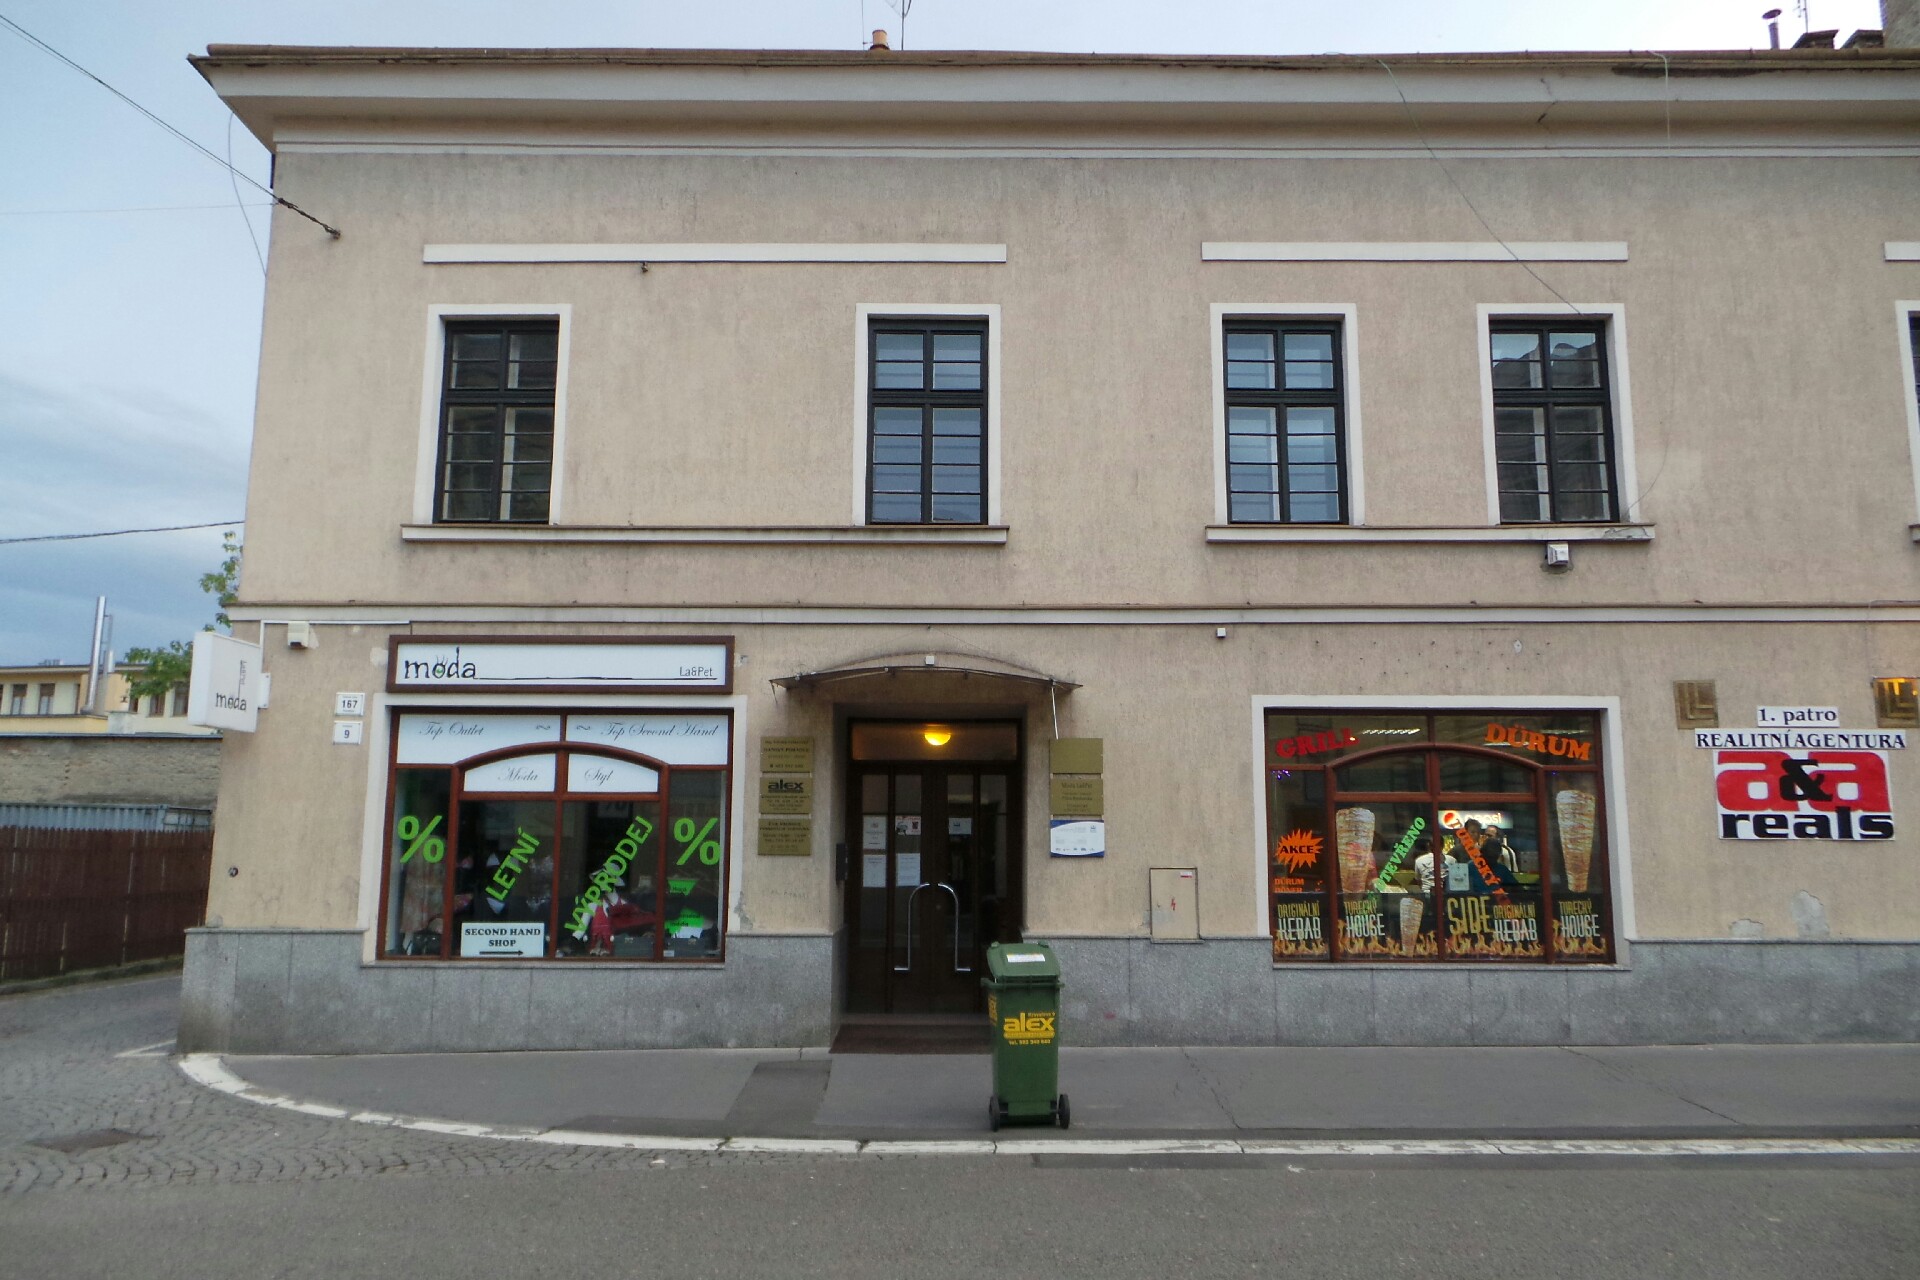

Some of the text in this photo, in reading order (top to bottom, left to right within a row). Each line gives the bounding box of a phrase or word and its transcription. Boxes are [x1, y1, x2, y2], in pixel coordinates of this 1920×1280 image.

[404, 646, 477, 680] moda
[679, 666, 714, 678] La&Pet
[215, 692, 248, 711] moda
[341, 699, 359, 709] 167
[1758, 708, 1838, 725] 1. patro
[343, 729, 351, 739] 9
[419, 720, 485, 741] Top Outlet
[601, 721, 719, 742] Top Second Hand
[1696, 729, 1907, 749] REALITNÍ AGENTURA
[1275, 728, 1360, 759] GRILL
[1484, 722, 1592, 761] DÜRUM
[498, 766, 539, 782] Moda
[584, 766, 614, 786] Styl
[768, 778, 804, 790] alex
[1720, 806, 1896, 839] reals
[1279, 844, 1315, 855] AKCE
[1374, 816, 1426, 893] OTEVŘENO
[485, 826, 541, 901] LETNÍ
[564, 815, 653, 932] VÝPRODEJ
[1277, 900, 1321, 918] ORIGINÁLNÍ
[1343, 899, 1379, 916] TURECKÝ
[1447, 896, 1493, 935] SIDE
[1493, 902, 1537, 919] ORIGINÁLNÍ
[1558, 898, 1593, 915] TURECKÝ
[464, 928, 542, 936] SECOND HAND
[1277, 917, 1322, 941] KEBAB
[1345, 913, 1386, 938] HOUSE
[1493, 918, 1538, 942] KEBAB
[1560, 914, 1601, 938] HOUSE
[488, 939, 517, 947] SHOP
[1003, 1012, 1055, 1032] alex
